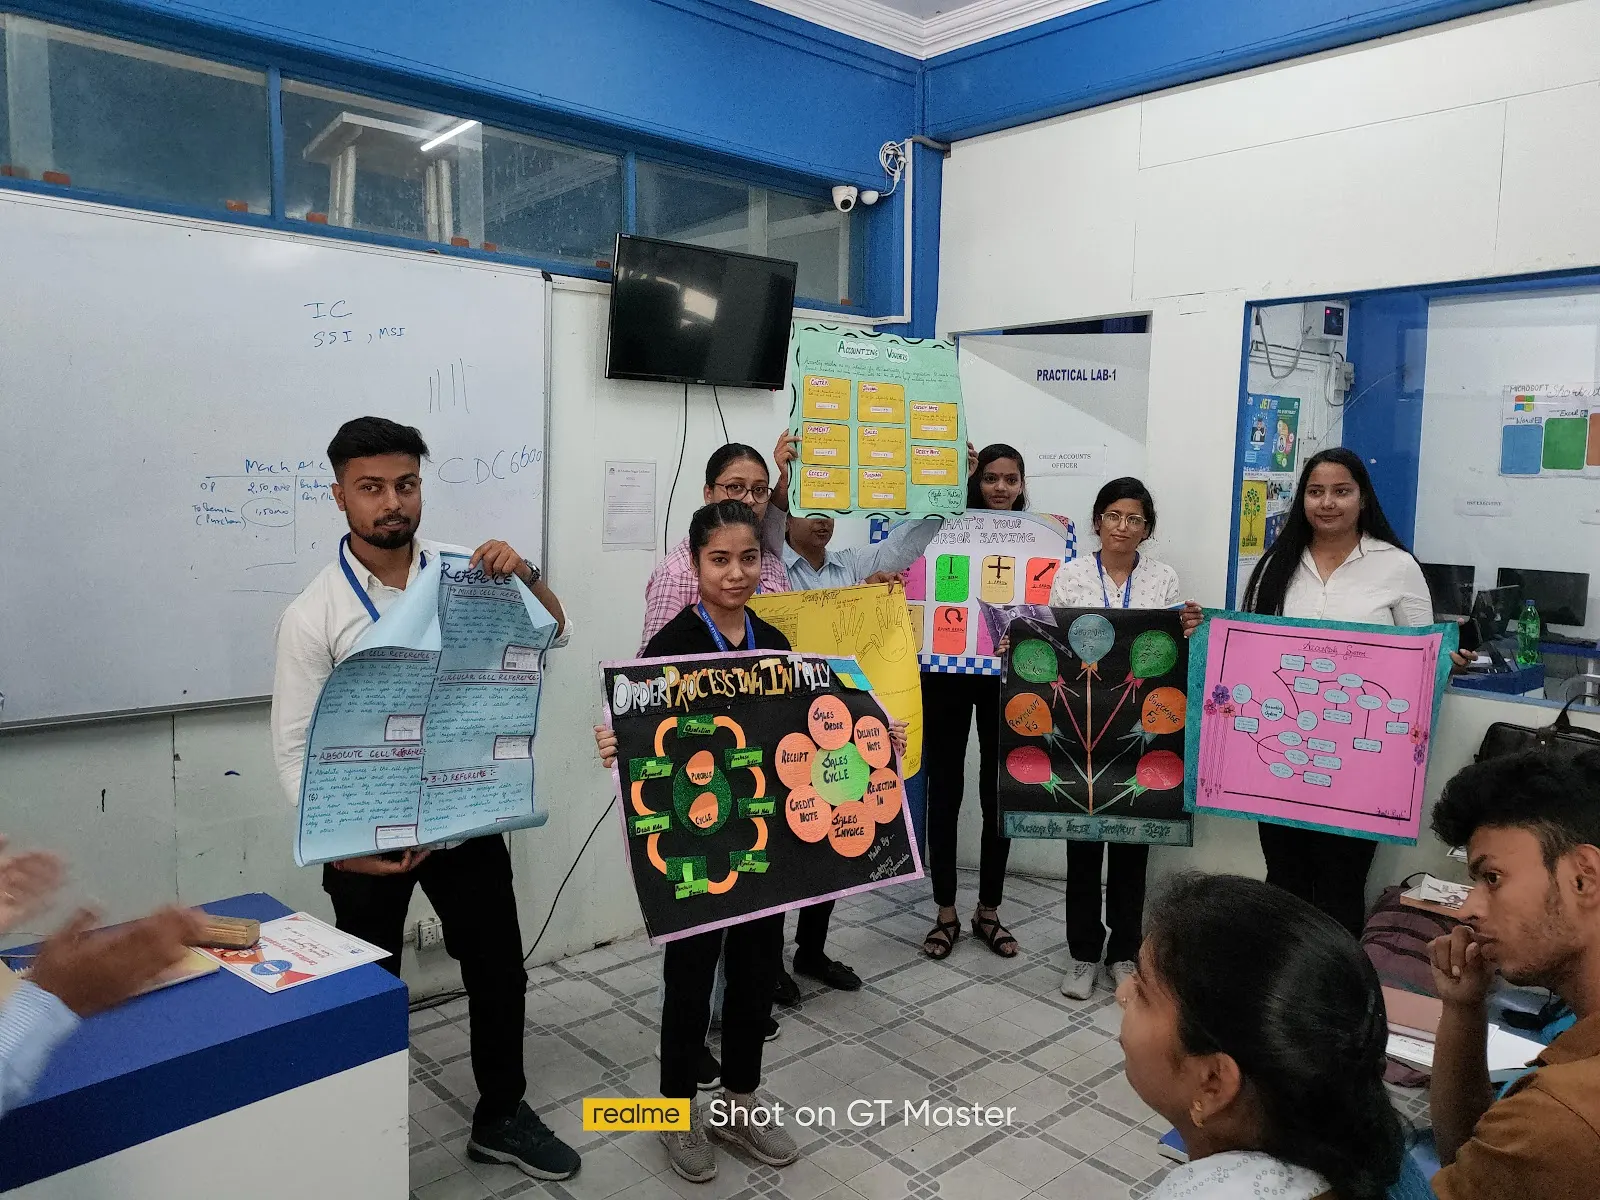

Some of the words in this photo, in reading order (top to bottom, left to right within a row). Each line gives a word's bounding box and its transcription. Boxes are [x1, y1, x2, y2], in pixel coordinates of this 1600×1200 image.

[304, 300, 353, 319] IC
[313, 331, 353, 348] SSI
[379, 327, 407, 340] MSI
[1036, 369, 1088, 381] PRACTICAL
[1090, 369, 1117, 381] LAB-1
[1509, 384, 1550, 394] MICROSOFT
[1260, 398, 1271, 410] JET
[941, 517, 985, 530] HAT'S
[993, 518, 1023, 530] YOUR
[931, 531, 971, 545] URSOR
[979, 532, 1036, 545] SAYING
[613, 674, 669, 716] ORDER
[664, 663, 763, 712] PROCESSING
[787, 654, 830, 691] TALLY
[812, 707, 835, 722] SALES
[1009, 698, 1041, 729] PAYMENT
[823, 721, 844, 731] ORDER
[1024, 722, 1039, 733] F5
[866, 741, 882, 752] NOTE
[319, 749, 364, 761] ABSOLUTE
[369, 748, 391, 759] CELL
[781, 749, 809, 765] RECEIPT
[821, 752, 849, 770] SALES
[823, 768, 850, 785] CYCLE
[866, 780, 897, 795] REJECTION
[789, 797, 816, 812] CREDIT
[876, 795, 884, 807] IN
[694, 812, 713, 825] CYCLE
[799, 811, 819, 823] NOTE
[831, 812, 858, 828] SALES
[834, 826, 865, 839] INVOICE
